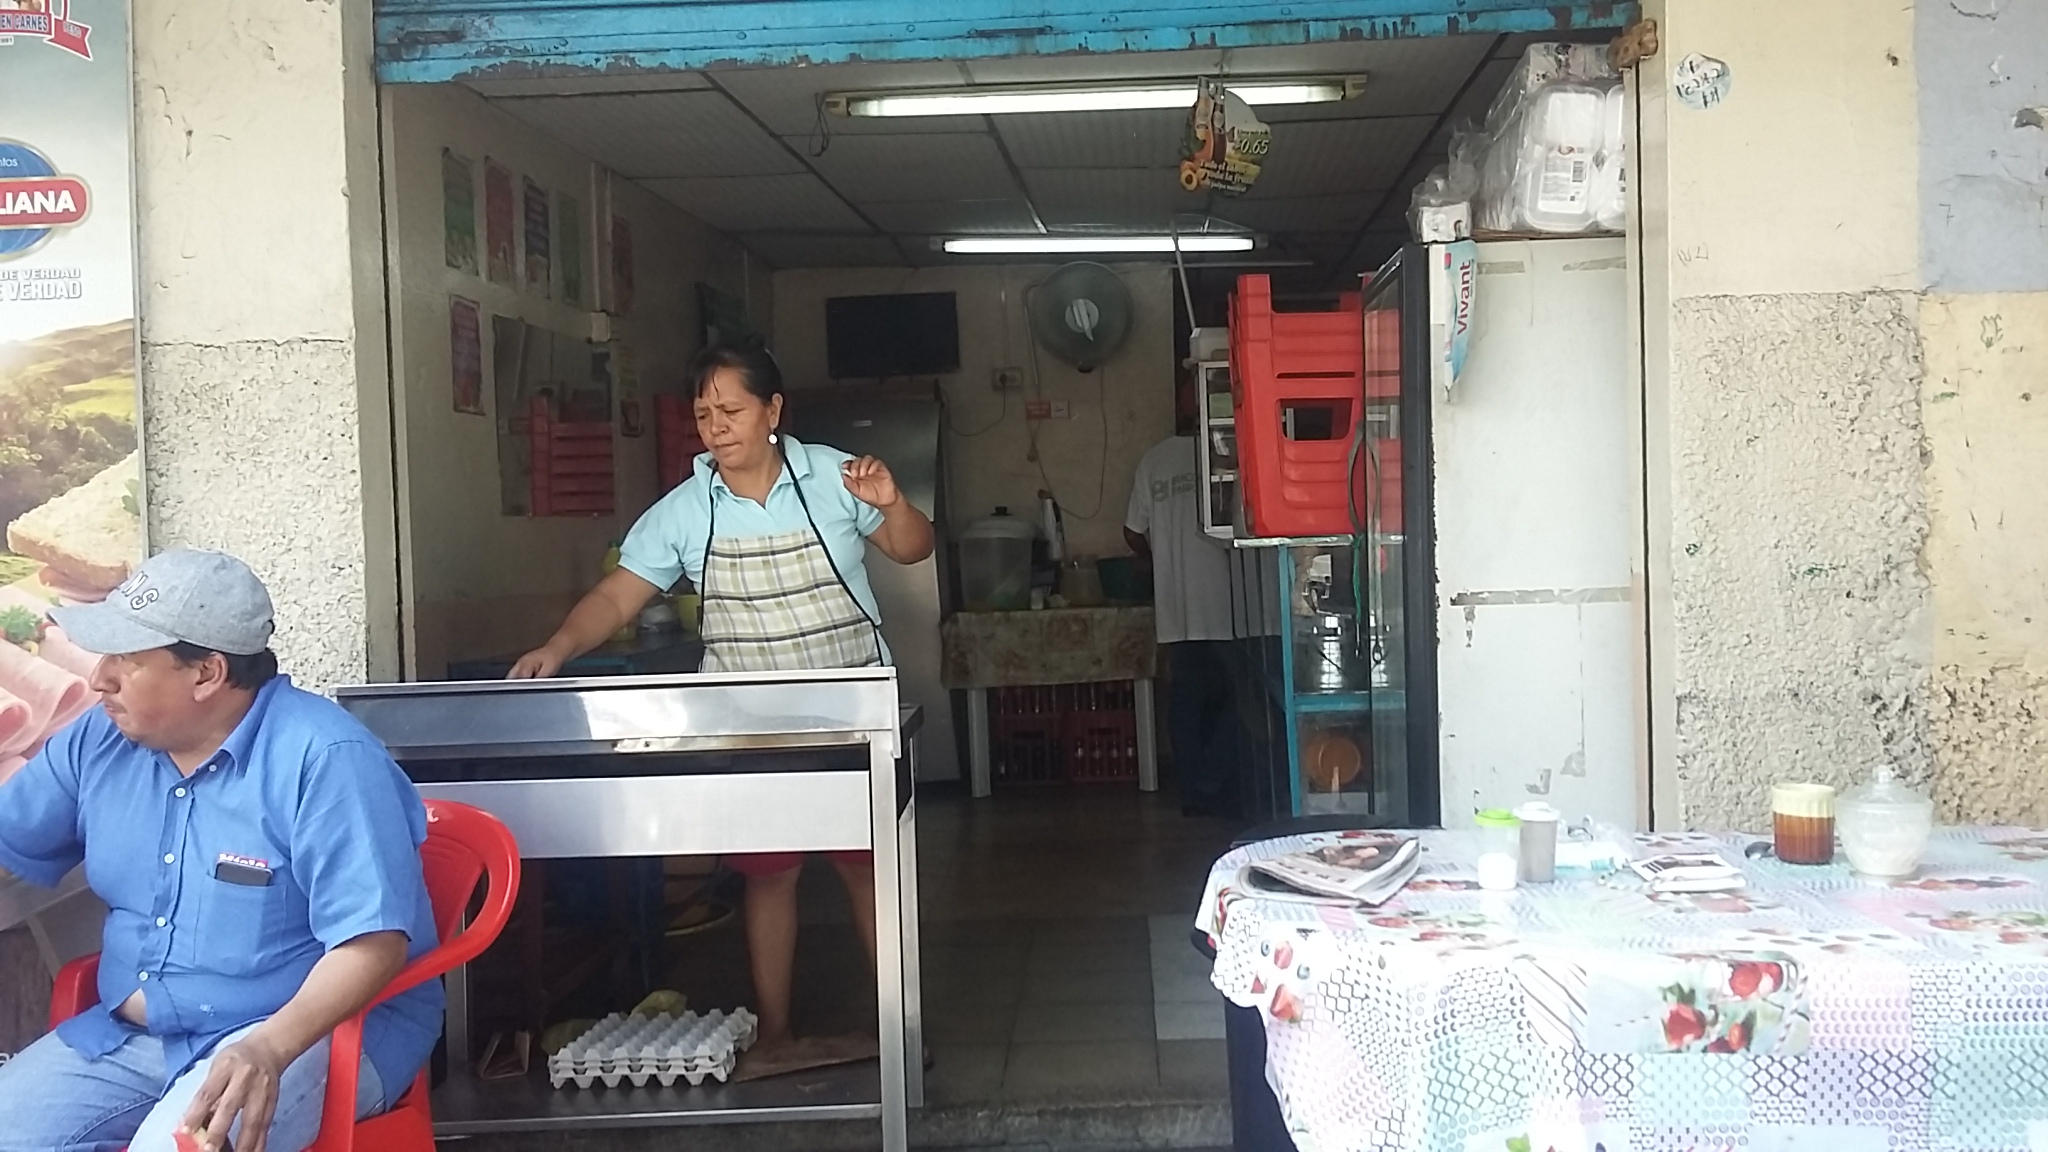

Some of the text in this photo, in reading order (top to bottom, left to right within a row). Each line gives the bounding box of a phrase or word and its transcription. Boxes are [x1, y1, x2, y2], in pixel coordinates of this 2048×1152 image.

[0, 13, 48, 31] EN CARNES
[21, 268, 81, 280] VERDAD
[8, 280, 82, 301] VERDAD
[1457, 259, 1471, 335] Vivant
[120, 571, 160, 611] NS
